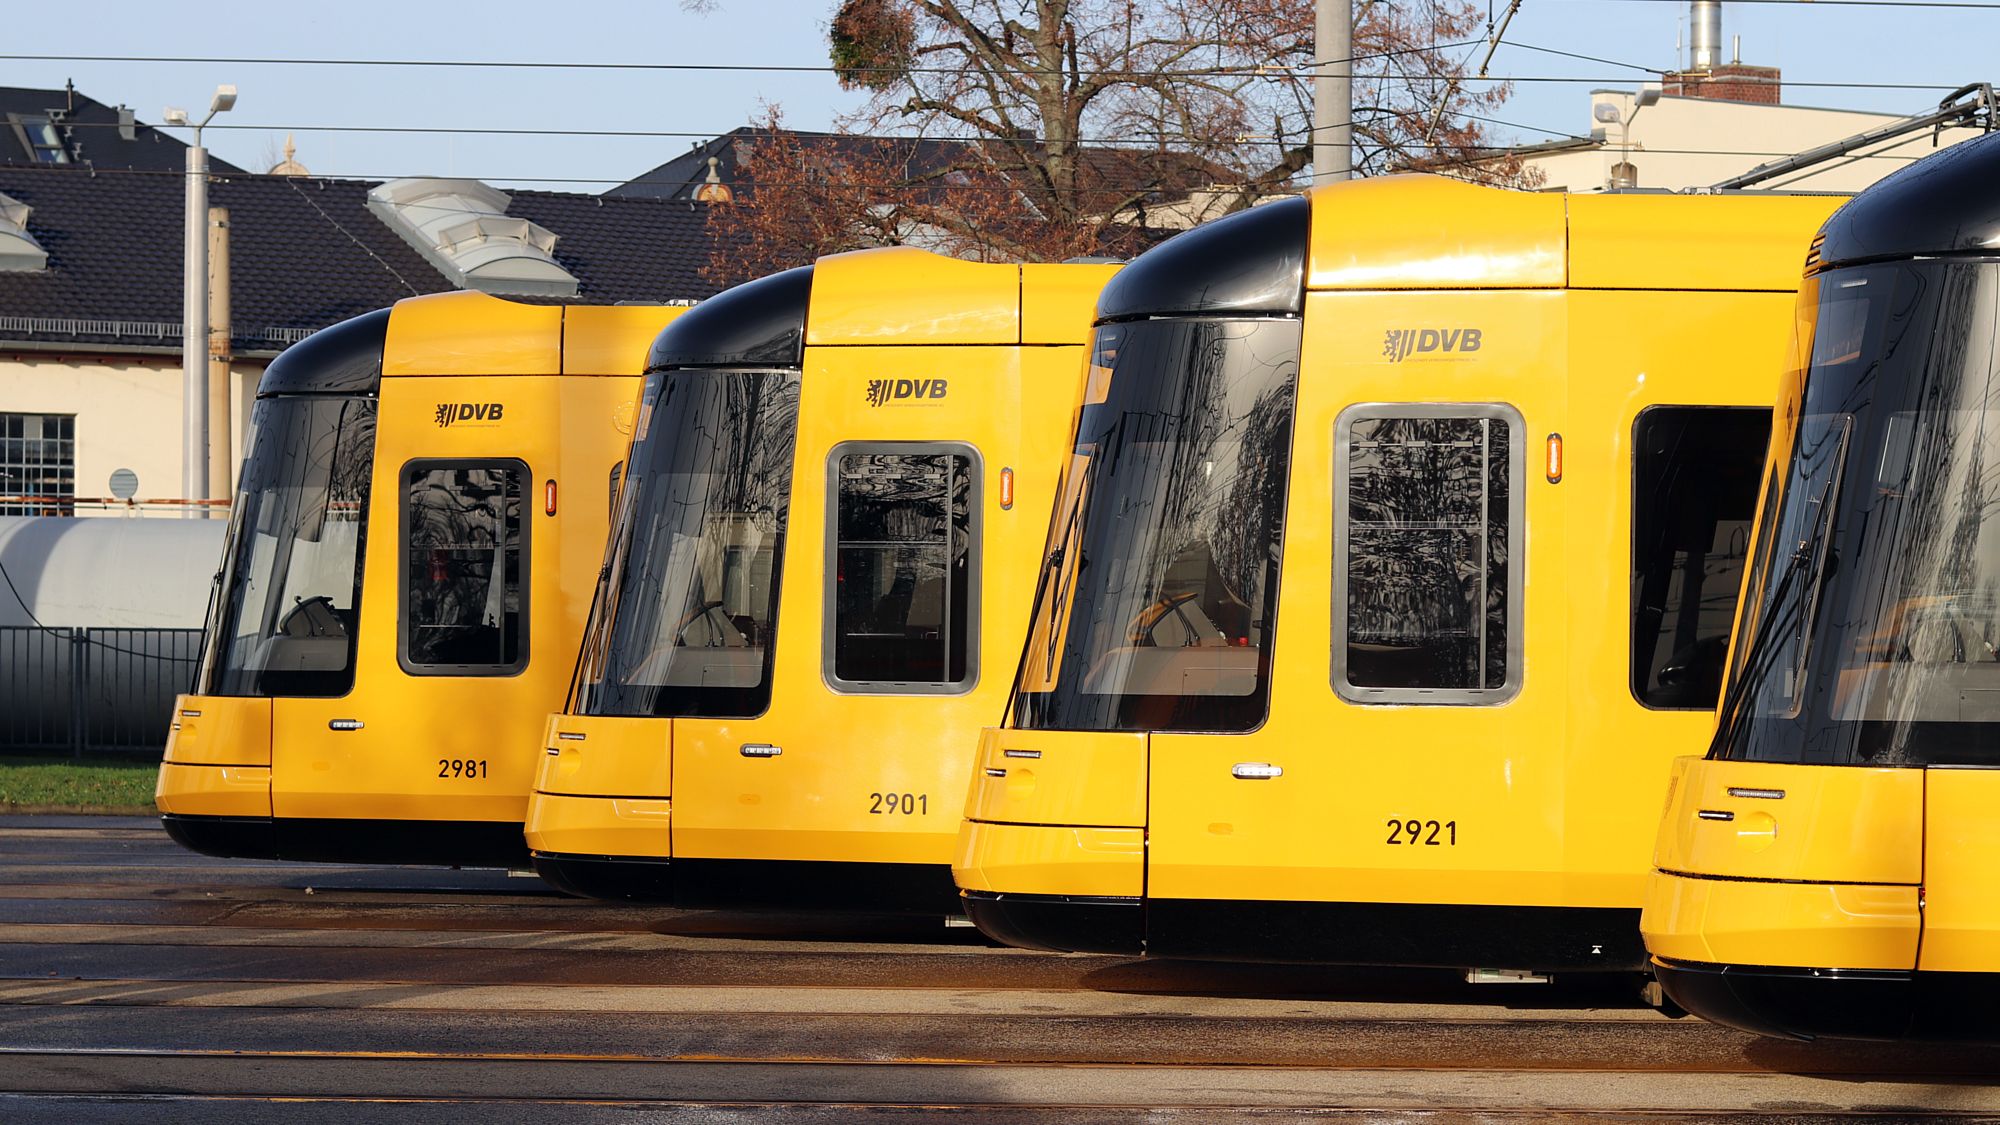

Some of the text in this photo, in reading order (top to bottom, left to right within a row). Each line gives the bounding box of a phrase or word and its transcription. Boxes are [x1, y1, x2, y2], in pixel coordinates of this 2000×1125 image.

[1417, 329, 1481, 352] DVB
[894, 379, 947, 398] DVB
[458, 403, 503, 420] DVB
[438, 759, 487, 779] 2981
[869, 793, 927, 815] 2901
[1386, 819, 1456, 846] 2921
